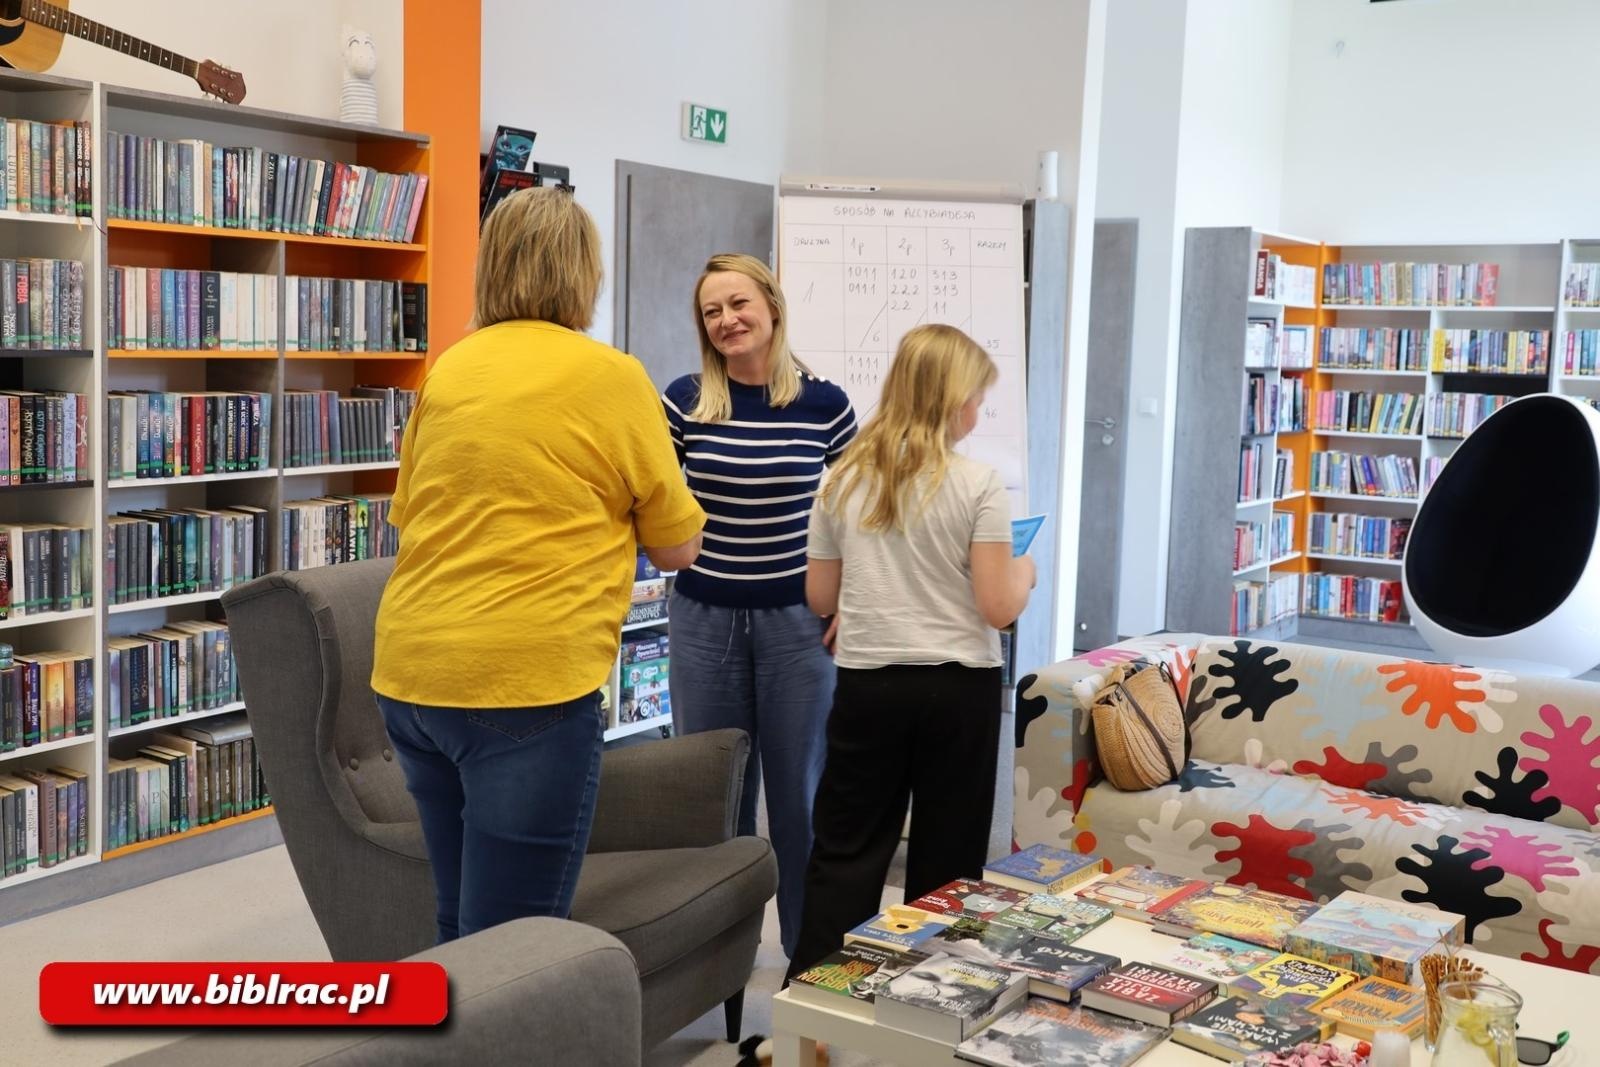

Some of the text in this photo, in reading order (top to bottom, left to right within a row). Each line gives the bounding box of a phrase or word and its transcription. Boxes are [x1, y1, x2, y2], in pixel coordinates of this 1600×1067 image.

[833, 203, 876, 216] SPOSÓB
[883, 207, 895, 217] NA
[17, 275, 28, 304] FOBIA
[1111, 977, 1152, 992] OJCA
[1123, 970, 1193, 993] SANDRONE
[1130, 966, 1202, 989] DAZIERI
[1098, 980, 1160, 1002] ZABIĆ
